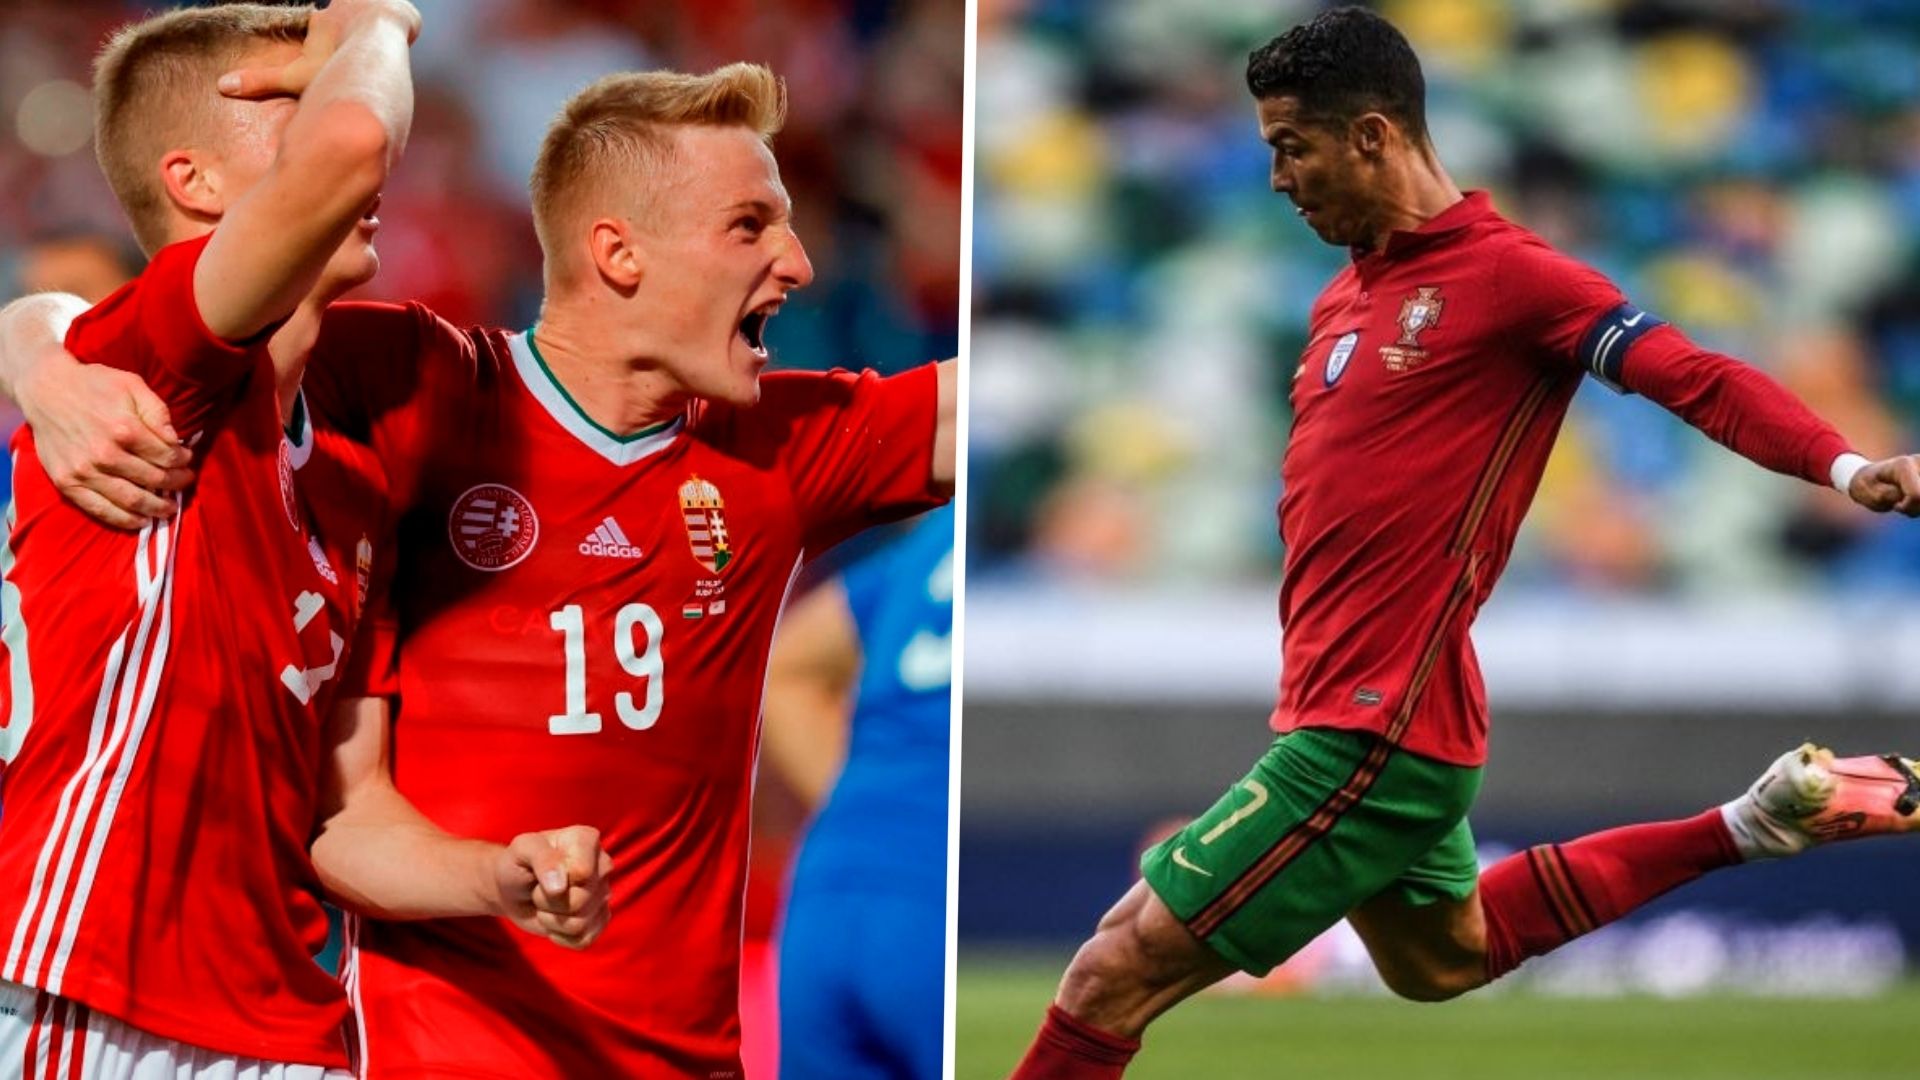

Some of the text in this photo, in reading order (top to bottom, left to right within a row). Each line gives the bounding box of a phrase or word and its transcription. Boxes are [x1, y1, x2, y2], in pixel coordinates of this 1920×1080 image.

[579, 542, 643, 558] adidas
[548, 603, 664, 735] 19
[1200, 779, 1268, 845] 7
